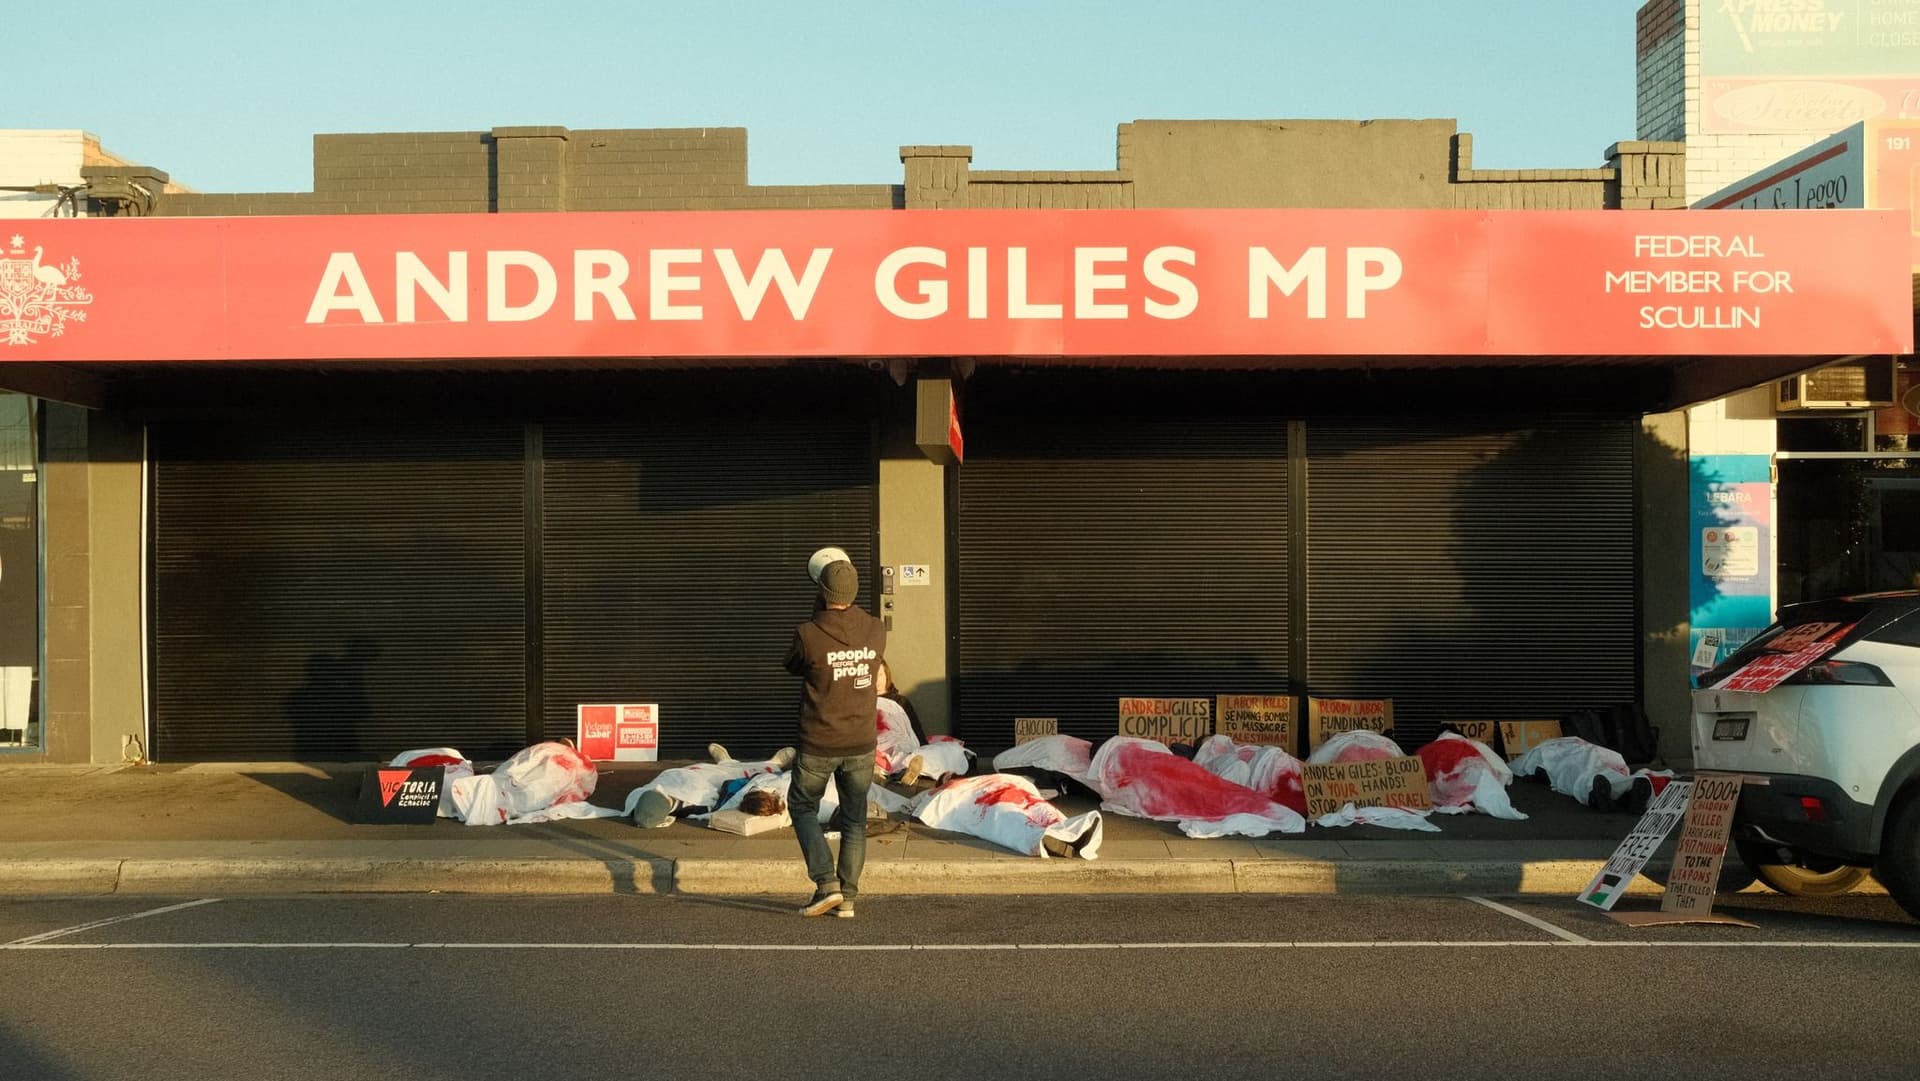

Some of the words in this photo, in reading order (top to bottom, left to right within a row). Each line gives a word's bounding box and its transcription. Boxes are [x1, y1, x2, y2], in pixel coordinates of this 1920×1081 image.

[1750, 13, 1842, 32] MONEY
[1885, 137, 1911, 150] 191
[1634, 235, 1764, 258] FEDERAL
[305, 247, 834, 324] ANDREW
[874, 245, 1199, 320] GILES
[1248, 246, 1403, 319] MP
[1605, 270, 1724, 293] MEMBER
[1733, 270, 1795, 293] FOR
[1639, 305, 1761, 329] SCULLIN
[1706, 492, 1752, 503] LEBARA
[827, 646, 877, 665] people
[833, 663, 870, 681] profit
[1121, 700, 1172, 715] ANDREW
[1172, 700, 1208, 716] GILES
[1226, 697, 1259, 710] LABOR
[1263, 696, 1288, 709] KILLS
[1320, 701, 1351, 713] BLOODY
[1352, 702, 1384, 715] LABOR
[1225, 710, 1261, 722] SENDING
[1264, 711, 1289, 722] BOMBS
[585, 729, 612, 739] Labor
[1016, 719, 1057, 736] GENOCIDE
[1125, 716, 1209, 738] COMPLICIT
[1225, 722, 1238, 731] TO
[1242, 722, 1287, 732] MASSACRE
[1450, 722, 1488, 737] TOP
[1303, 766, 1346, 782] ANDREW
[1349, 763, 1382, 779] GILES:
[1385, 760, 1420, 776] BLOOD
[382, 781, 436, 793] VICTORIA
[1307, 783, 1323, 798] ON
[1327, 782, 1359, 798] YOUR
[1362, 776, 1407, 793] HANDS!
[1693, 779, 1738, 801] 15000+
[1309, 798, 1337, 815] STOP
[1385, 792, 1428, 807] ISRAEL
[1692, 800, 1730, 812] CHILDREN
[1703, 828, 1723, 840] GAVE
[1619, 836, 1658, 859] FREE
[1684, 855, 1695, 868] TO
[1695, 856, 1713, 868] THE
[1671, 869, 1712, 884] WEAPONS
[1670, 882, 1688, 894] THAT
[1688, 884, 1711, 896] KILLED
[1675, 894, 1696, 909] THEM
